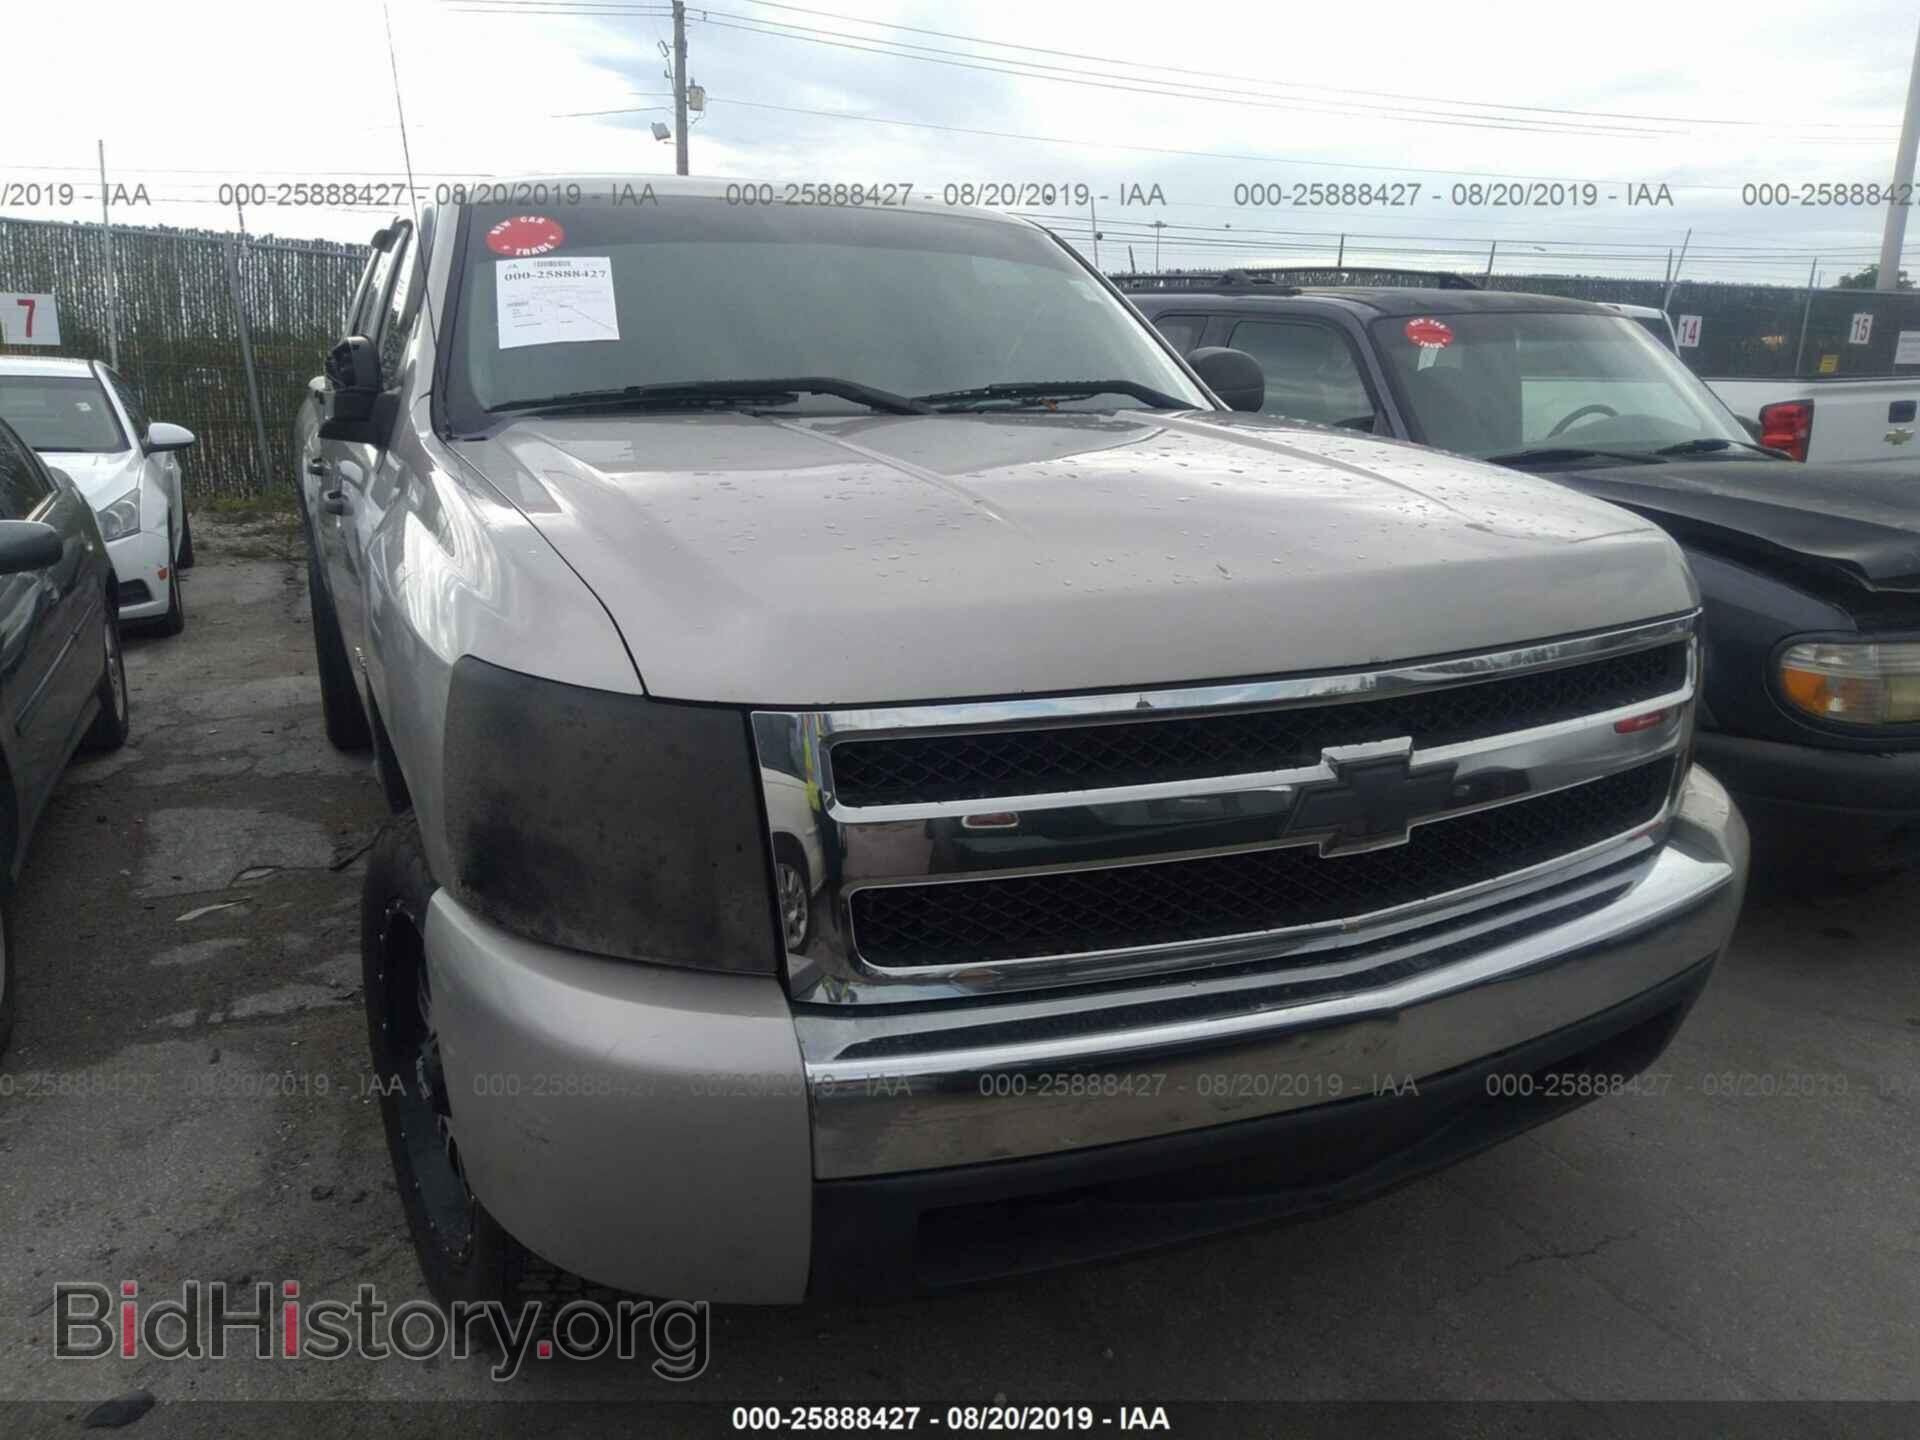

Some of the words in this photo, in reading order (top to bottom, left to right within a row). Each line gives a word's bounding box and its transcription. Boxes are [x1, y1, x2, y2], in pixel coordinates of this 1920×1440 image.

[505, 270, 607, 281] 000-25888427
[17, 299, 35, 337] 7
[1854, 318, 1870, 342] 15
[1681, 319, 1698, 345] 14
